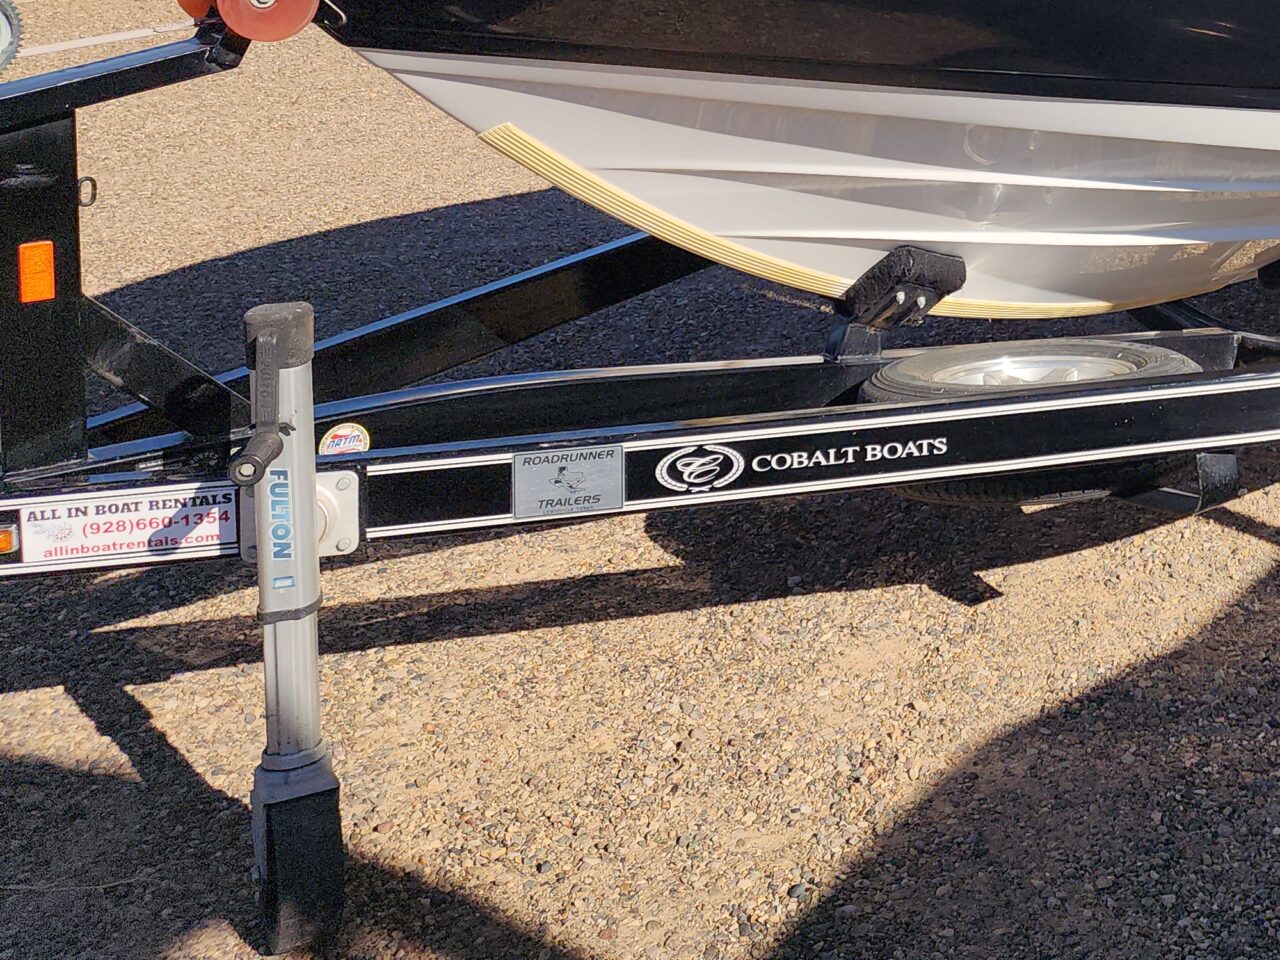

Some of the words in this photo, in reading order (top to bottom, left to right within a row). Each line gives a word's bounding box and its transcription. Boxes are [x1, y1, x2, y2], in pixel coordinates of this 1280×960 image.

[522, 449, 615, 466] ROADRUNNER
[751, 444, 861, 472] COBALT
[864, 437, 948, 462] BOATS
[26, 507, 61, 522] ALL
[66, 505, 89, 518] IN
[94, 500, 143, 516] BOAT
[148, 492, 234, 511] RENTALS
[269, 470, 292, 559] FULTON
[537, 494, 602, 509] TRAILERS
[82, 509, 231, 538] (928)660-1354
[43, 532, 222, 558] allinboatrentals.com
